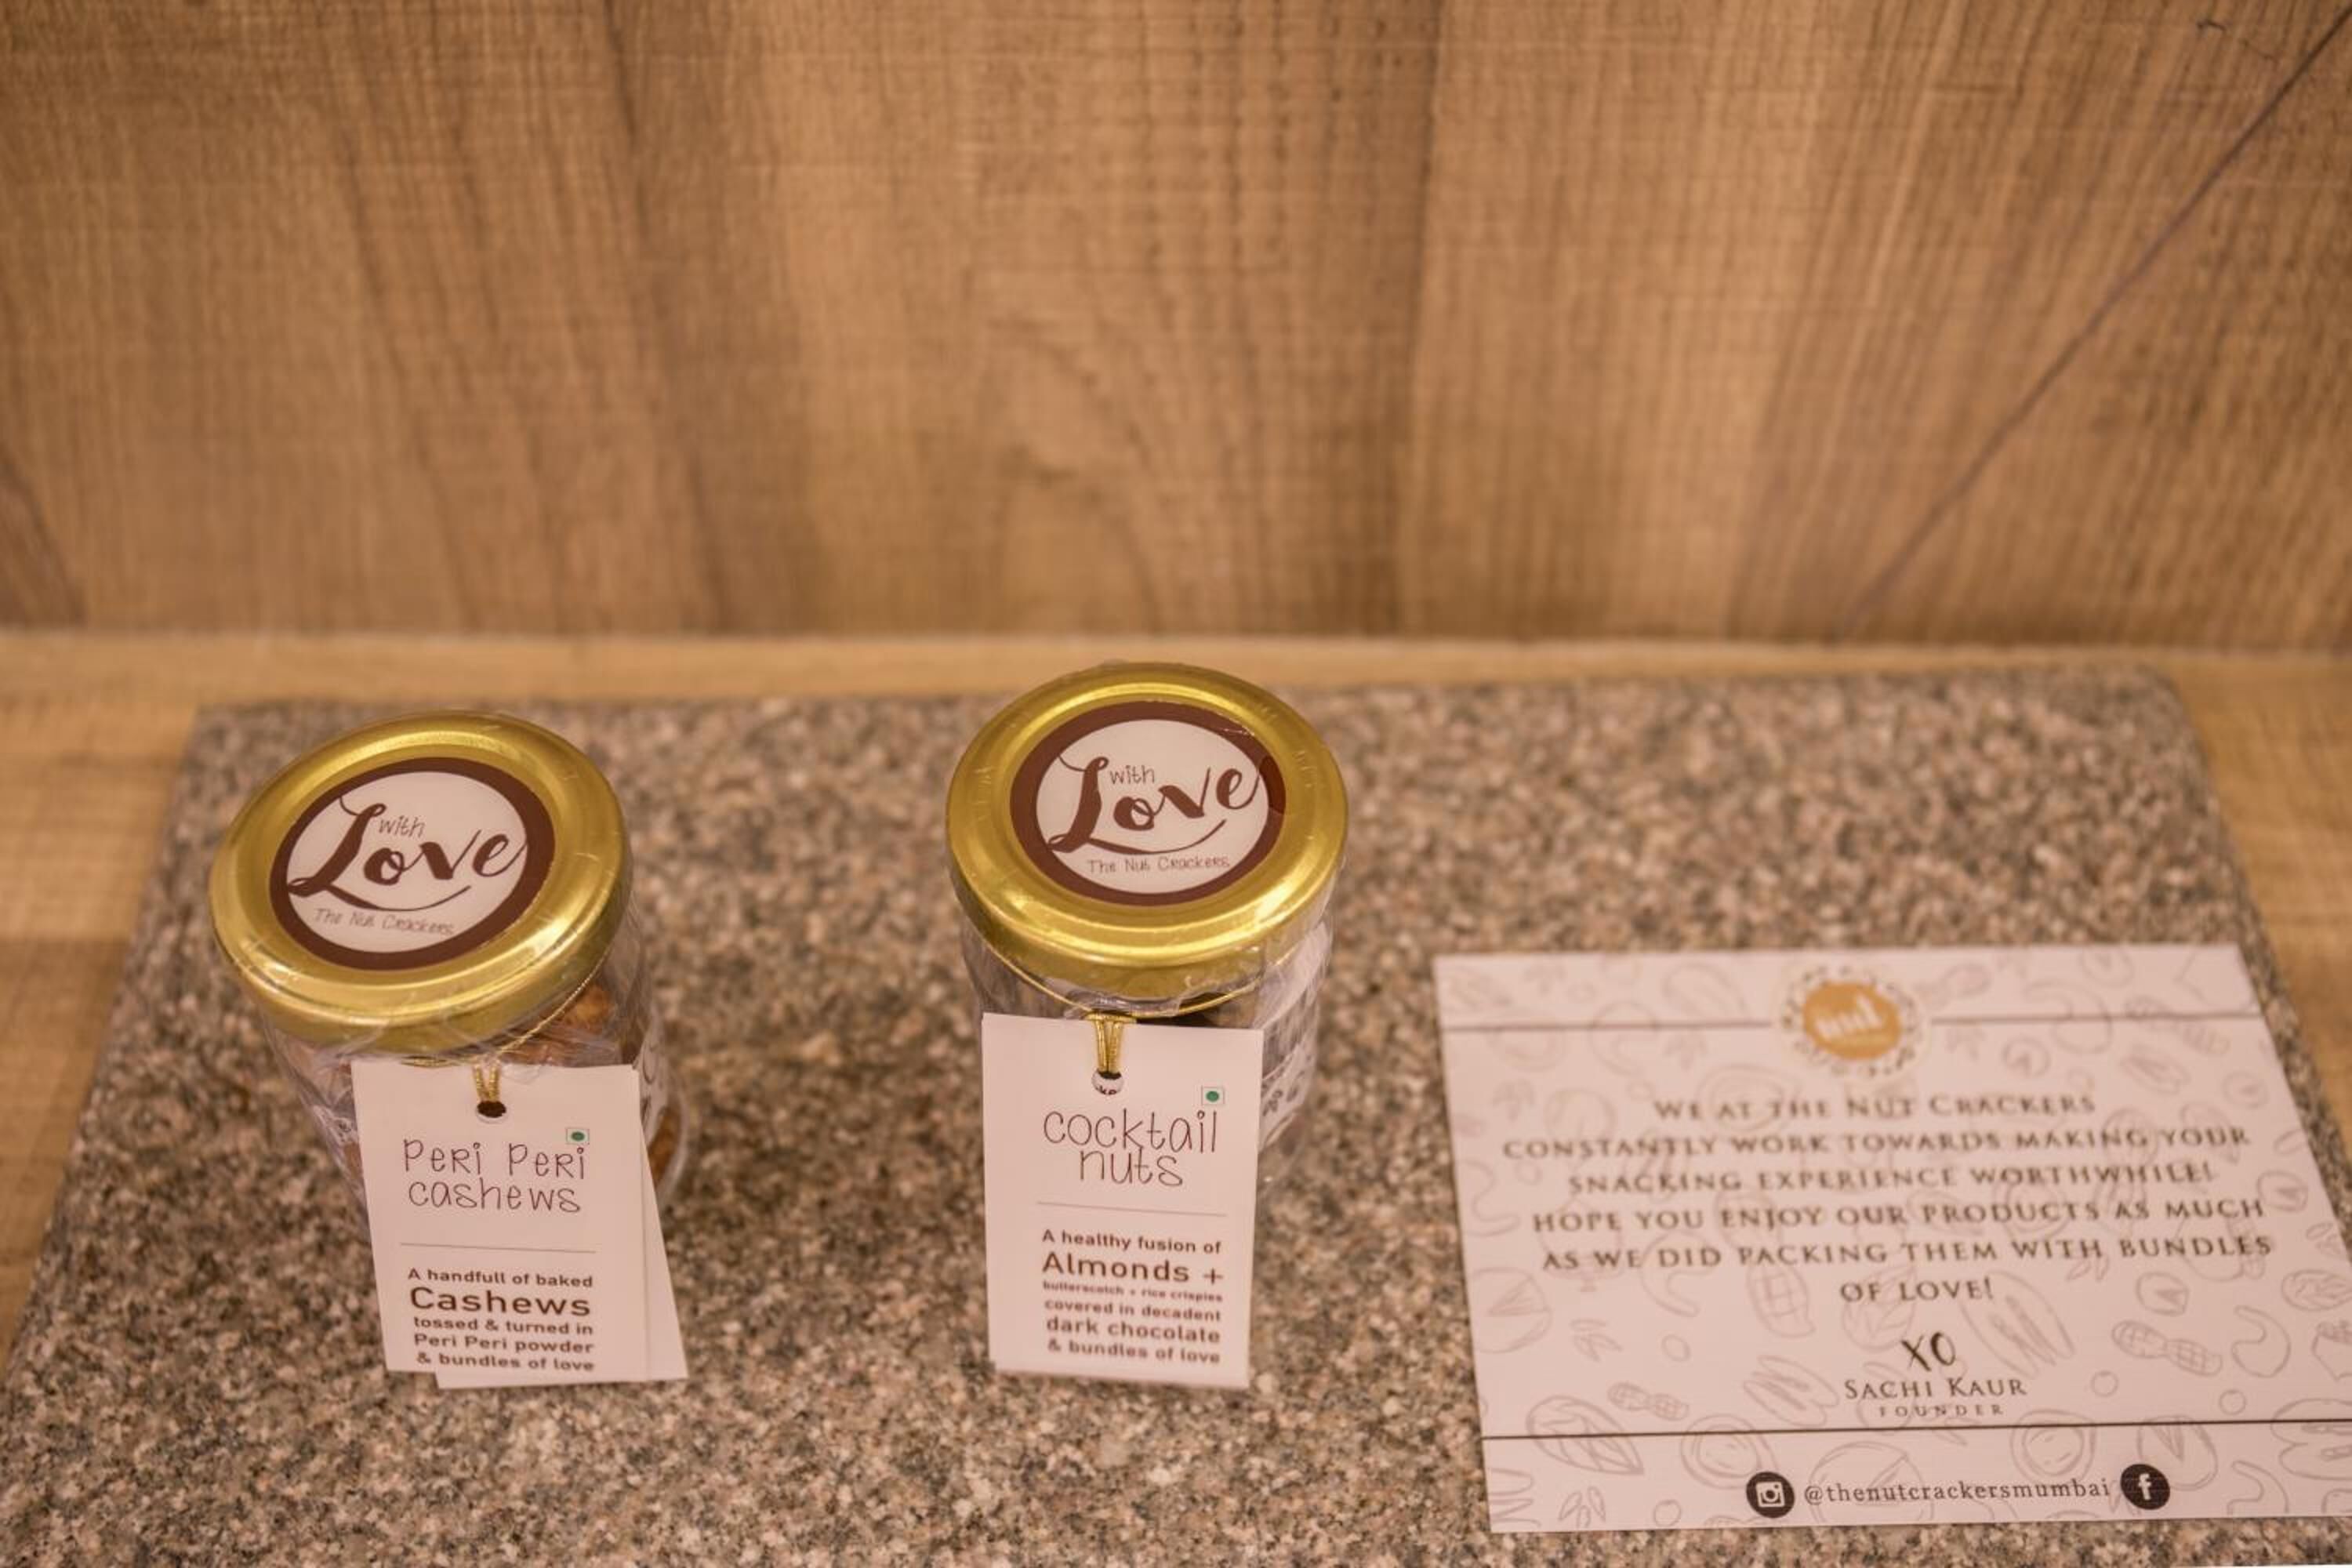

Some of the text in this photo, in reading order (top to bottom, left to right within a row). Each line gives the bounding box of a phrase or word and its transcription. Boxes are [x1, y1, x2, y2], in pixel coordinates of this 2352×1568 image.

[1109, 764, 1156, 784] with
[1047, 755, 1260, 855] Love
[379, 815, 426, 837] with
[288, 798, 528, 912] Love
[1654, 1100, 1701, 1121] WE
[1719, 1101, 1751, 1120] AT
[1769, 1100, 1831, 1120] THE
[1044, 1108, 1217, 1154] cocktail
[1502, 1127, 2250, 1160] CONSTANTLY WORK TOWARDS MAKING YOUR
[1080, 1146, 1183, 1187] nuts
[1568, 1161, 2215, 1194] SNACKING EXPERIENCE WORTHWHILE!
[408, 1177, 581, 1213] cashews
[1533, 1198, 2264, 1232] HOPE YOU ENJOY OUR PRODUCTS AS MUCH
[1042, 1229, 1221, 1254] A healthy fusion of
[1542, 1235, 2273, 1271] AS WE DID PACKING THEM WITH BUNDLES
[408, 1268, 593, 1287] A handfull of baked
[1042, 1251, 1189, 1283] Almonds
[410, 1287, 590, 1317] Cashews
[1043, 1281, 1124, 1295] butterscotch
[1142, 1287, 1166, 1298] rice
[1171, 1291, 1223, 1303] crispies
[1839, 1277, 1995, 1302] OF LOVE!
[1044, 1298, 1221, 1322] covered in decadent
[414, 1316, 593, 1335] tossed & turned in
[1046, 1316, 1220, 1344] dark chocolate
[414, 1333, 594, 1353] Peri Peri powder
[1069, 1341, 1148, 1359] bundles
[1156, 1348, 1173, 1361] of
[1181, 1348, 1220, 1363] love
[1901, 1331, 1958, 1371] XO
[416, 1352, 594, 1371] & bundles of love
[1879, 1404, 2005, 1417] FOUNDER
[1804, 1479, 2111, 1505] @thenutcrackersmumbai
